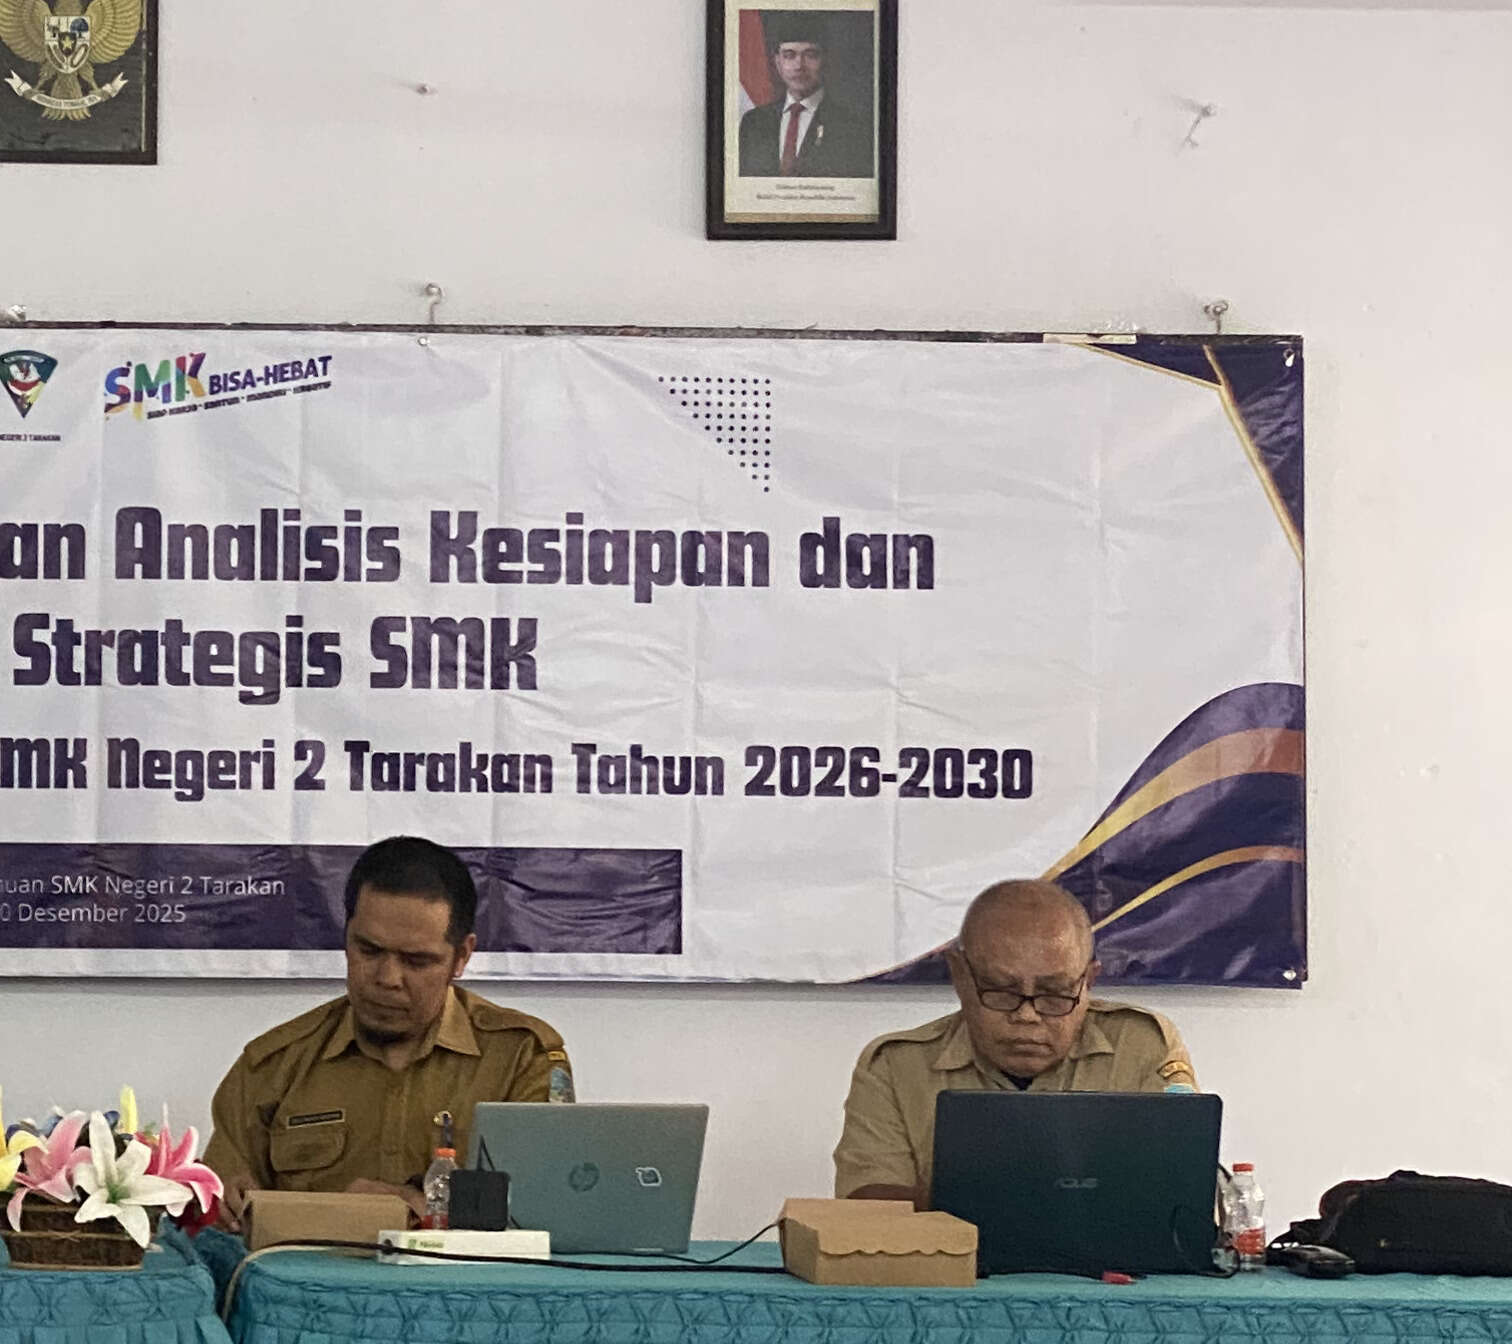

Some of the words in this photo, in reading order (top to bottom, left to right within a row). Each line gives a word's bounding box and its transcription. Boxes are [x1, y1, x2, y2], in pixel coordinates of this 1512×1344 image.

[104, 352, 207, 414] SMK
[209, 355, 333, 396] BISA-HEBAT
[115, 506, 401, 583] Analisis
[429, 510, 770, 604] Kesiapan
[799, 516, 935, 590] dan
[13, 612, 342, 706] Strategis
[369, 615, 538, 691] SMK
[106, 737, 276, 802] Negeri
[294, 739, 326, 791] 2
[343, 740, 553, 794] Tarakan
[571, 742, 725, 796] Tahun
[744, 745, 1033, 800] 2026-2030
[18, 903, 129, 923] Desember
[134, 903, 187, 923] 2025
[51, 875, 99, 894] SMK
[105, 874, 174, 899] Negeri
[180, 875, 193, 895] 2
[199, 875, 286, 897] Tarakan
